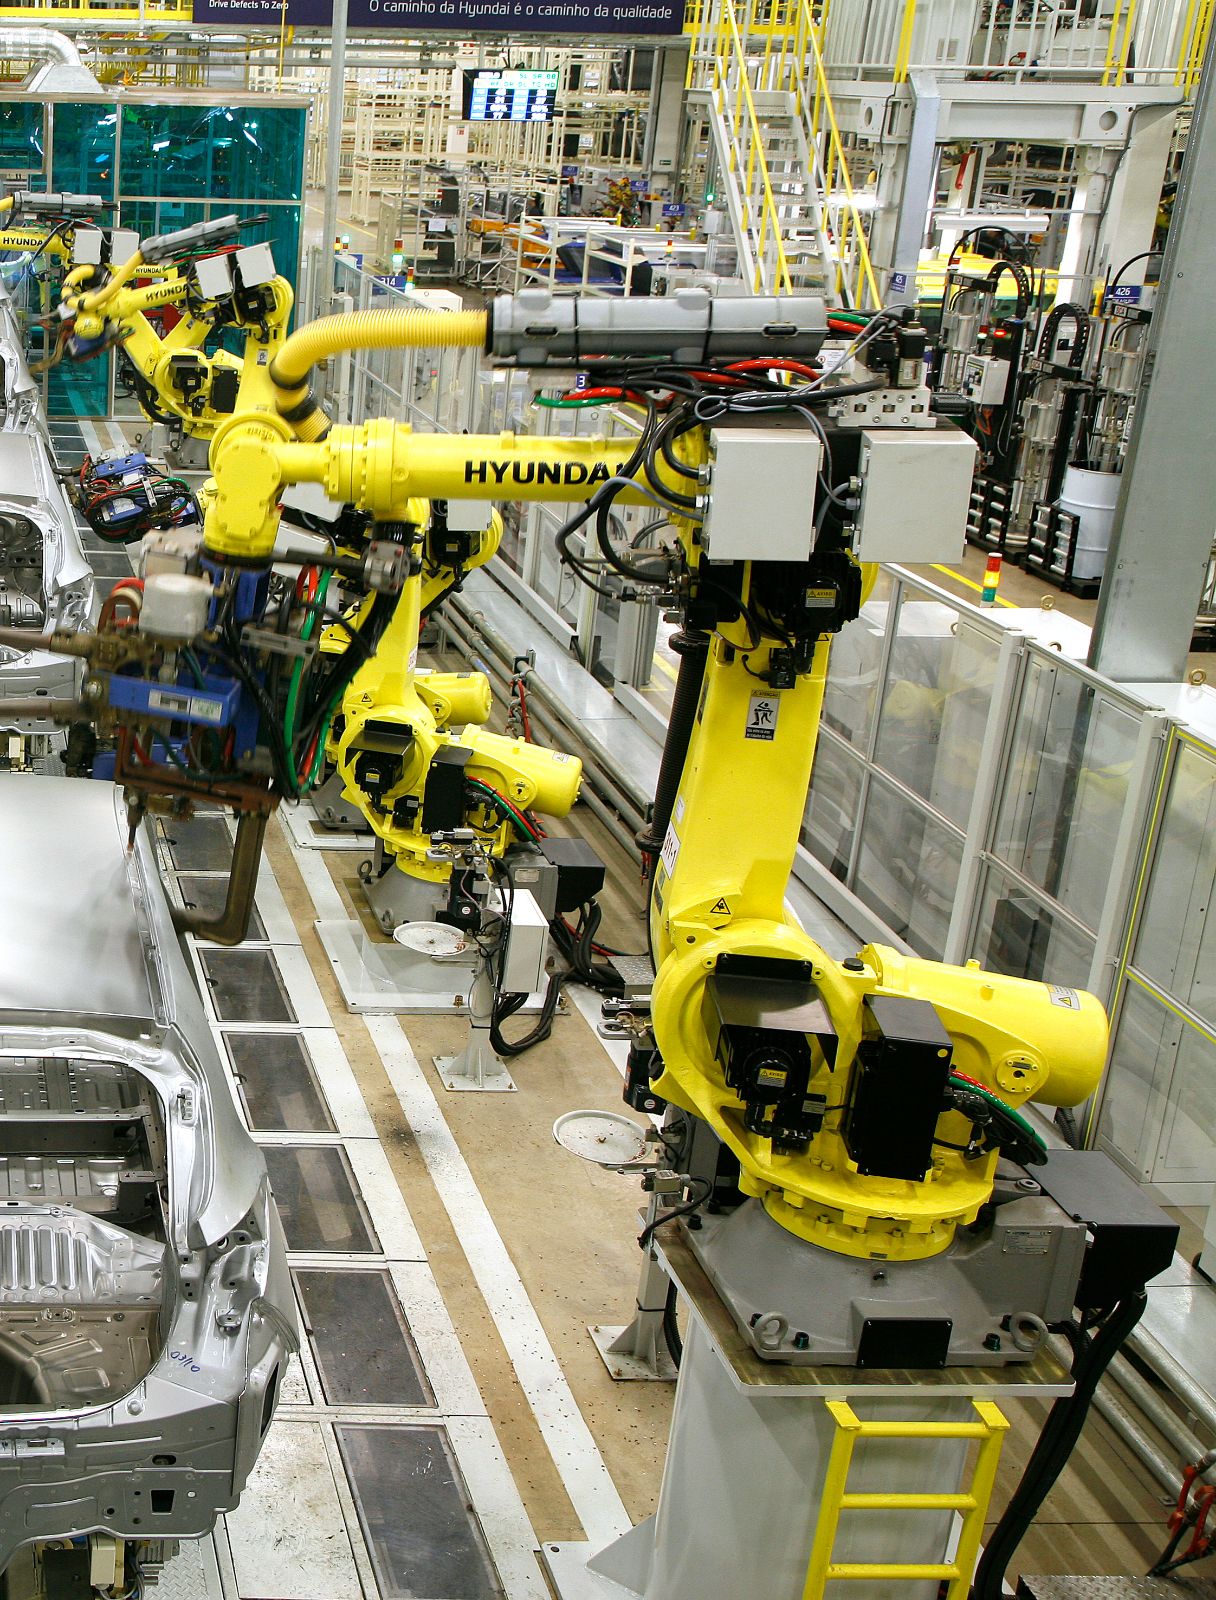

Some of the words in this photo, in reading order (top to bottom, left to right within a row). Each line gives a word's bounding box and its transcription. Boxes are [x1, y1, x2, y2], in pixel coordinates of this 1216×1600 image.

[209, 0, 228, 9] Drive
[230, 0, 258, 9] Defects
[261, 0, 270, 9] To
[369, 0, 379, 12] O
[383, 0, 436, 13] caminho
[439, 1, 455, 14] da
[459, 2, 510, 18] Hyundai
[514, 3, 522, 15] é
[526, 6, 534, 15] o
[538, 4, 590, 17] caminho
[594, 4, 609, 18] da
[613, 5, 672, 20] qualidade
[3, 237, 43, 246] HYUNDA
[146, 284, 188, 301] HYUNDA
